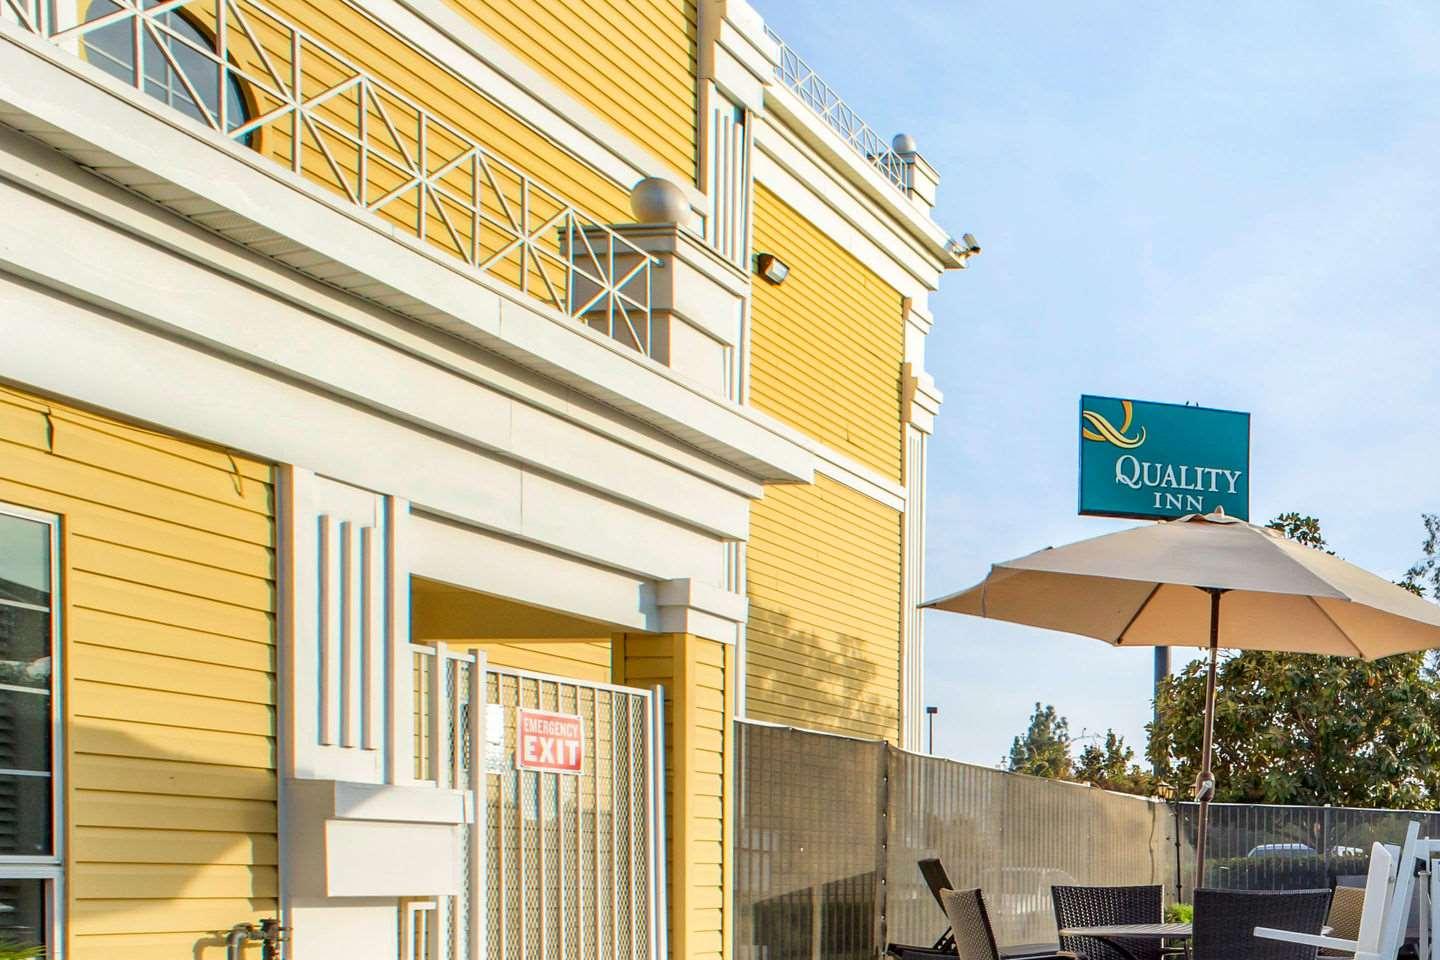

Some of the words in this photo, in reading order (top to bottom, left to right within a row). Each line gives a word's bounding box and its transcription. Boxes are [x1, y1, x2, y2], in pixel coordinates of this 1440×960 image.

[1115, 455, 1242, 493] QUALITY
[1153, 492, 1204, 511] INN
[525, 718, 579, 737] EMERGENCY
[524, 735, 579, 766] EXIT
